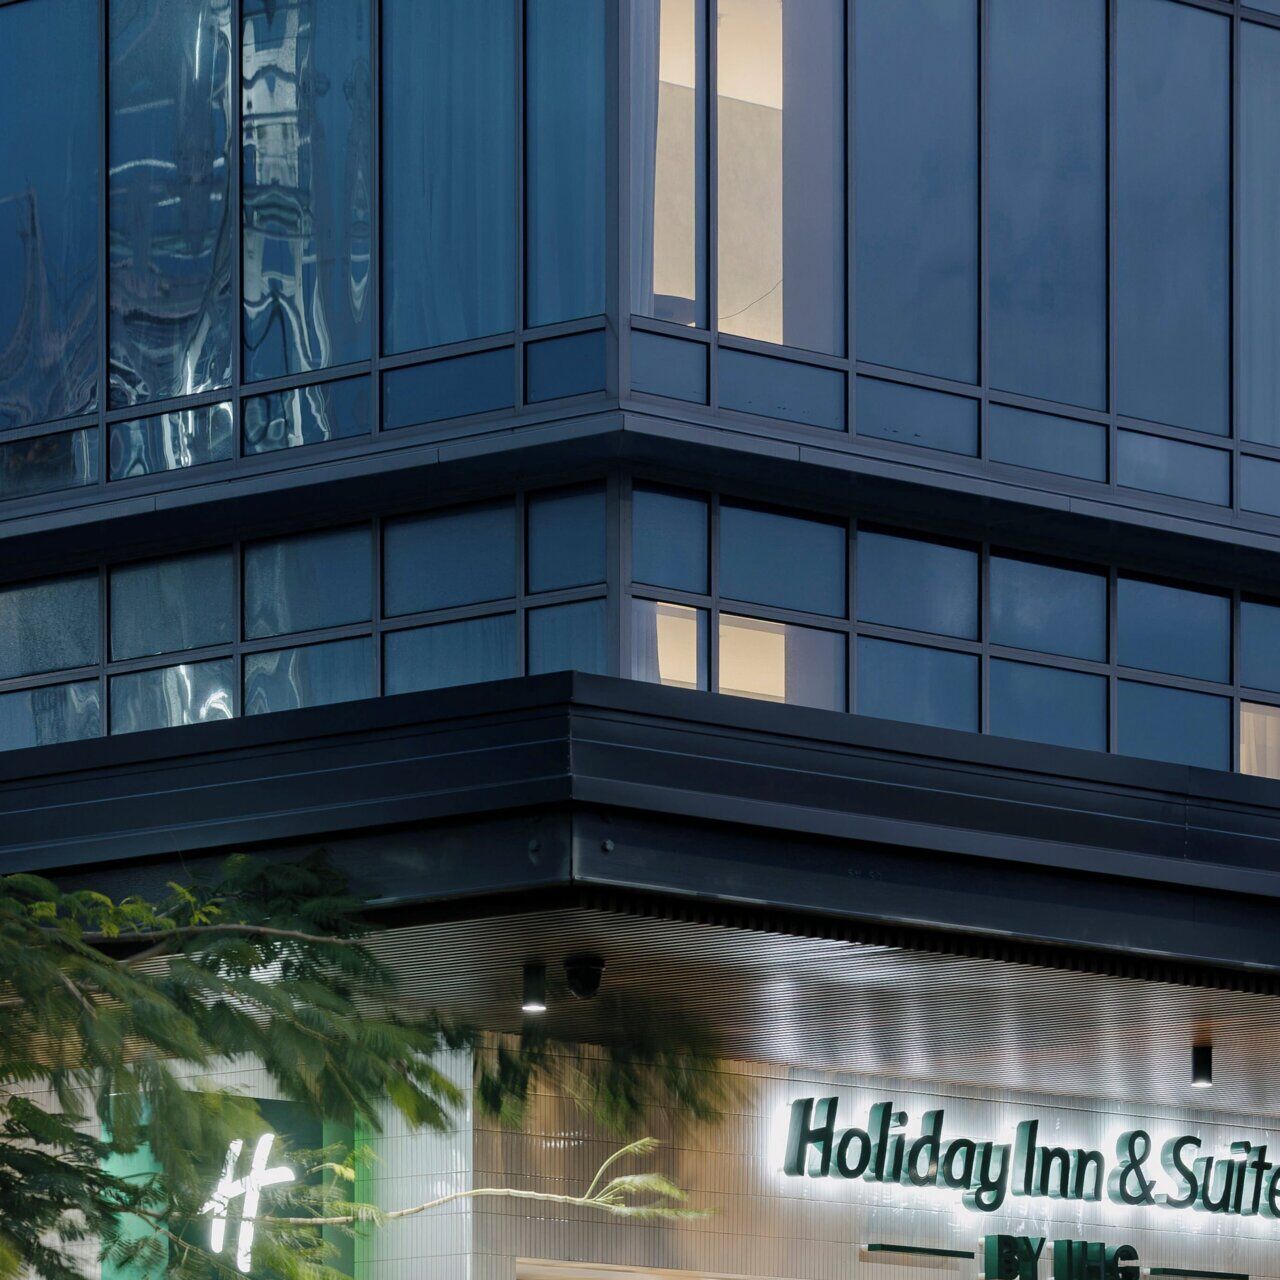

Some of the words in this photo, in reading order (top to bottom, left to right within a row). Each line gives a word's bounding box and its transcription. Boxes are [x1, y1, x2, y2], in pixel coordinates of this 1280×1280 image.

[784, 1096, 1012, 1212] Holiday
[1011, 1119, 1103, 1202] Inn
[1108, 1129, 1157, 1206] &
